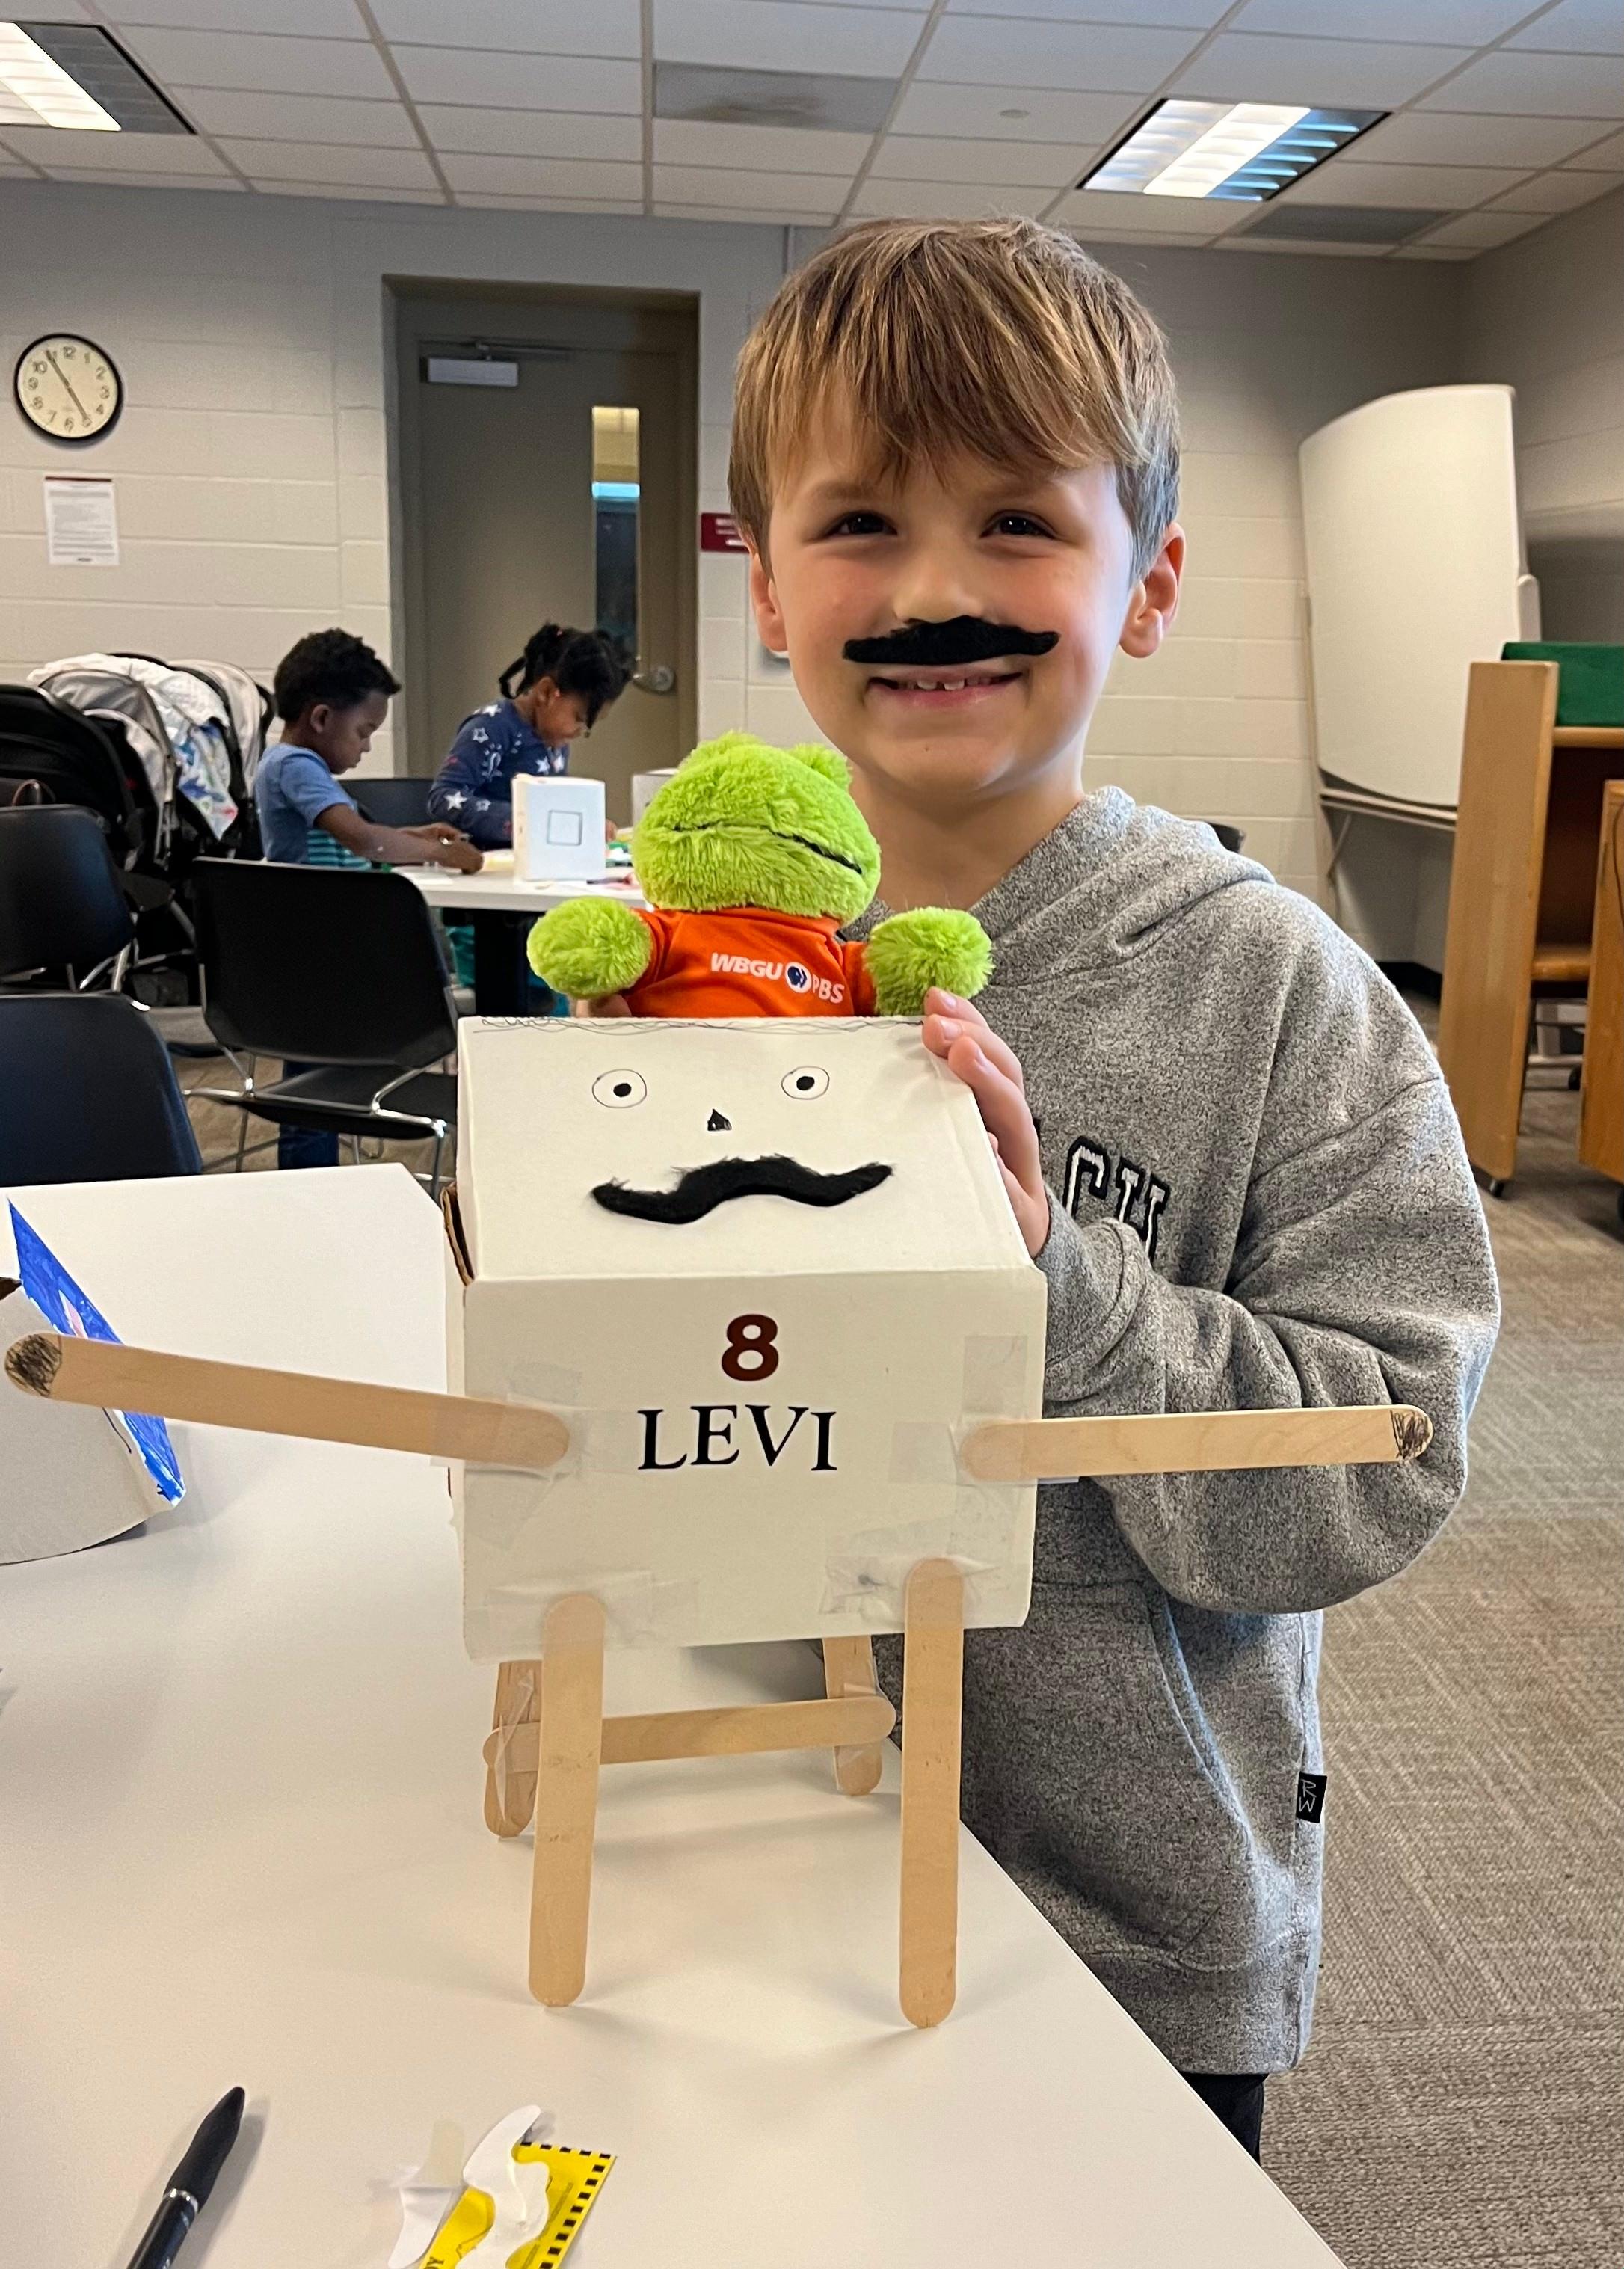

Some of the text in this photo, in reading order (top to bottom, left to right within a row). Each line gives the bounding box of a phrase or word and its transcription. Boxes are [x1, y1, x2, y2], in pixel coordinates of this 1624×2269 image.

[710, 952, 846, 1004] WBGU PBS
[721, 1314, 779, 1381] 8
[637, 1404, 837, 1471] LEVI
